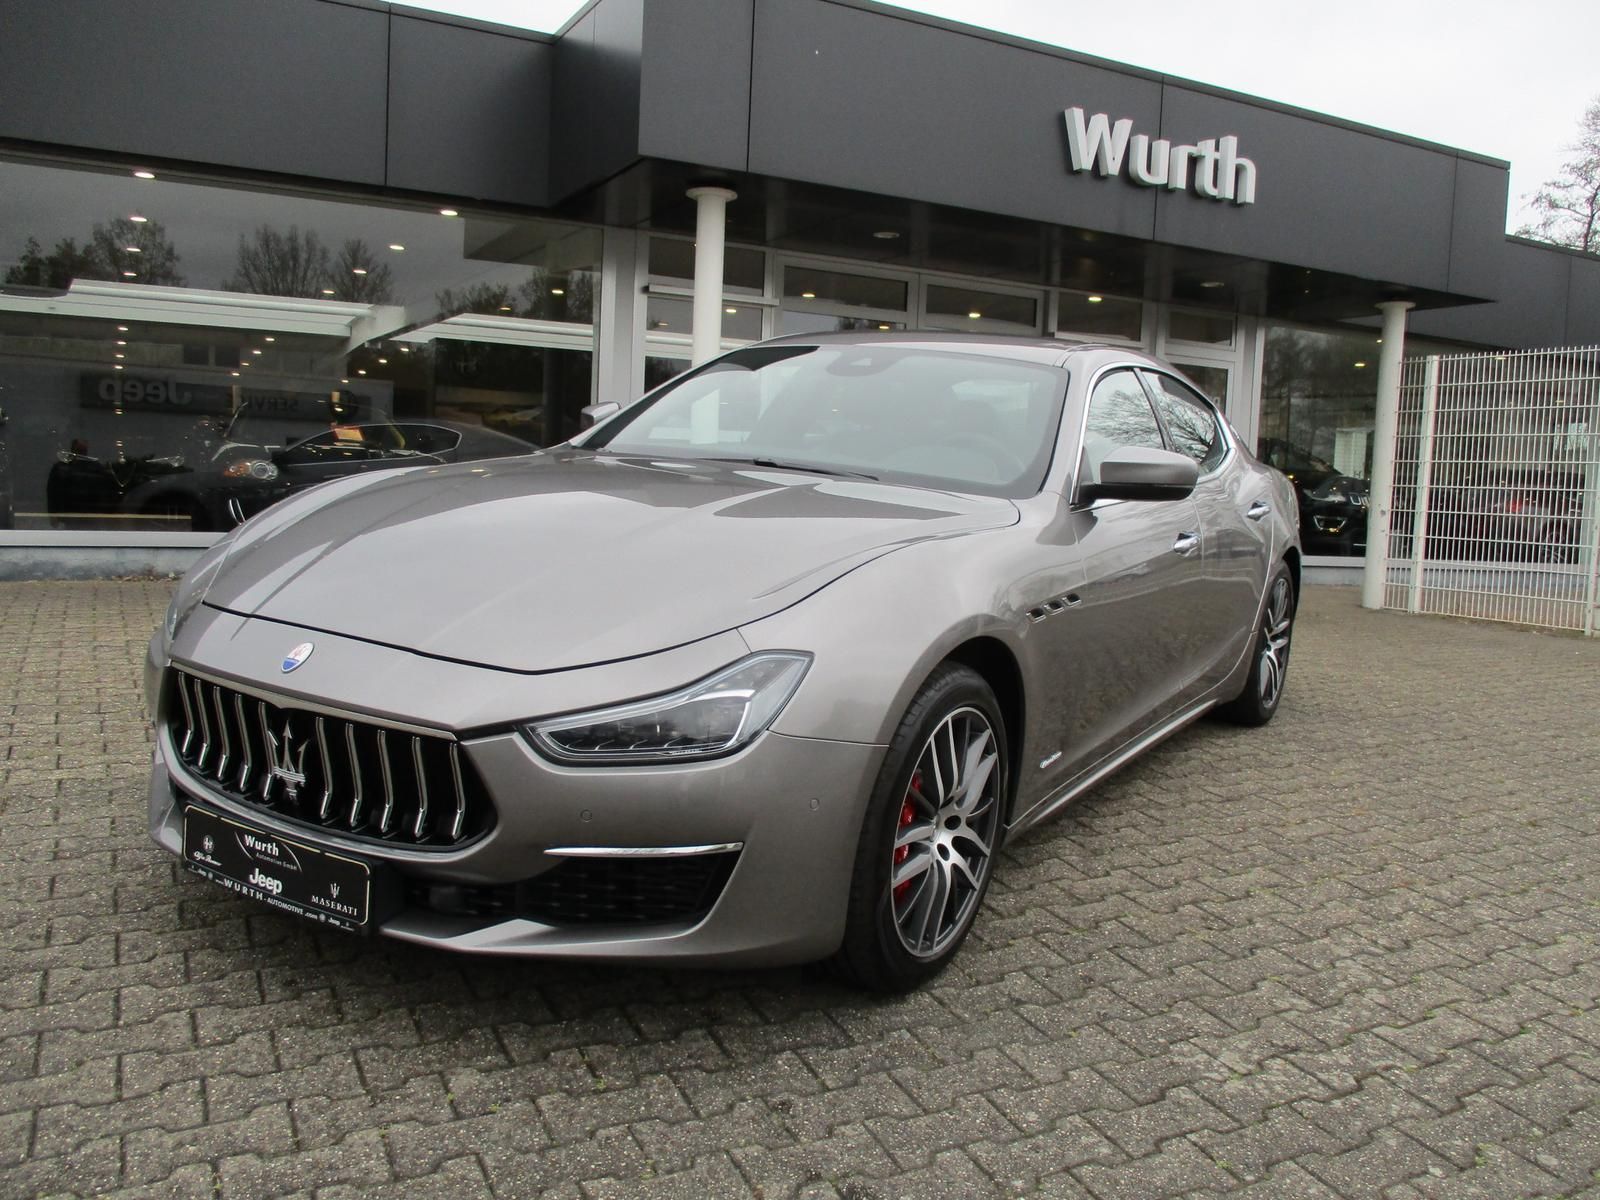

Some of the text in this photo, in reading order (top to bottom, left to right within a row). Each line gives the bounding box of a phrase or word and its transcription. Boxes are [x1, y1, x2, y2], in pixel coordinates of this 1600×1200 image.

[1064, 106, 1257, 205] Wurth
[244, 834, 279, 857] Wurth
[249, 867, 283, 895] Jeep
[311, 895, 358, 916] MASERATI
